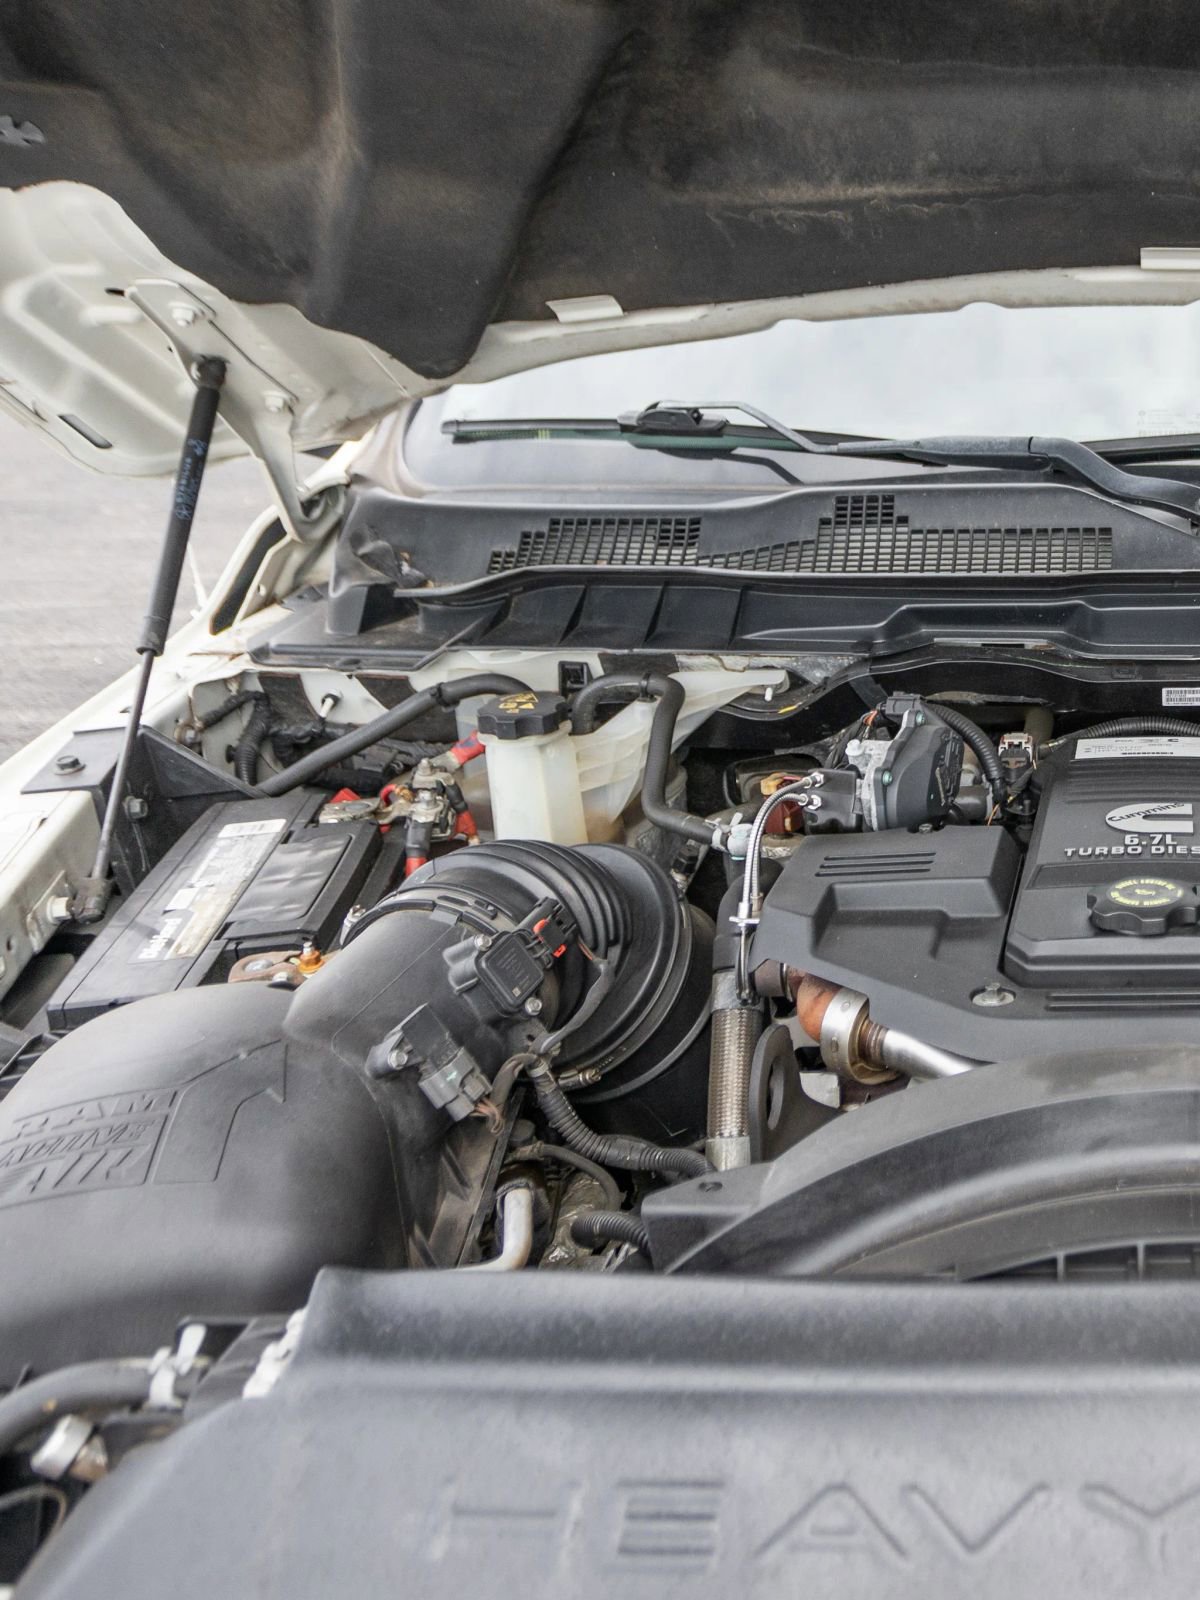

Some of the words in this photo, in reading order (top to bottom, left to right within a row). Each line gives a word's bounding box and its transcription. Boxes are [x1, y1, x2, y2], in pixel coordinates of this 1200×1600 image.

[1106, 803, 1185, 822] Cummins
[1124, 834, 1178, 847] 6.7L
[1064, 846, 1143, 858] TURBO
